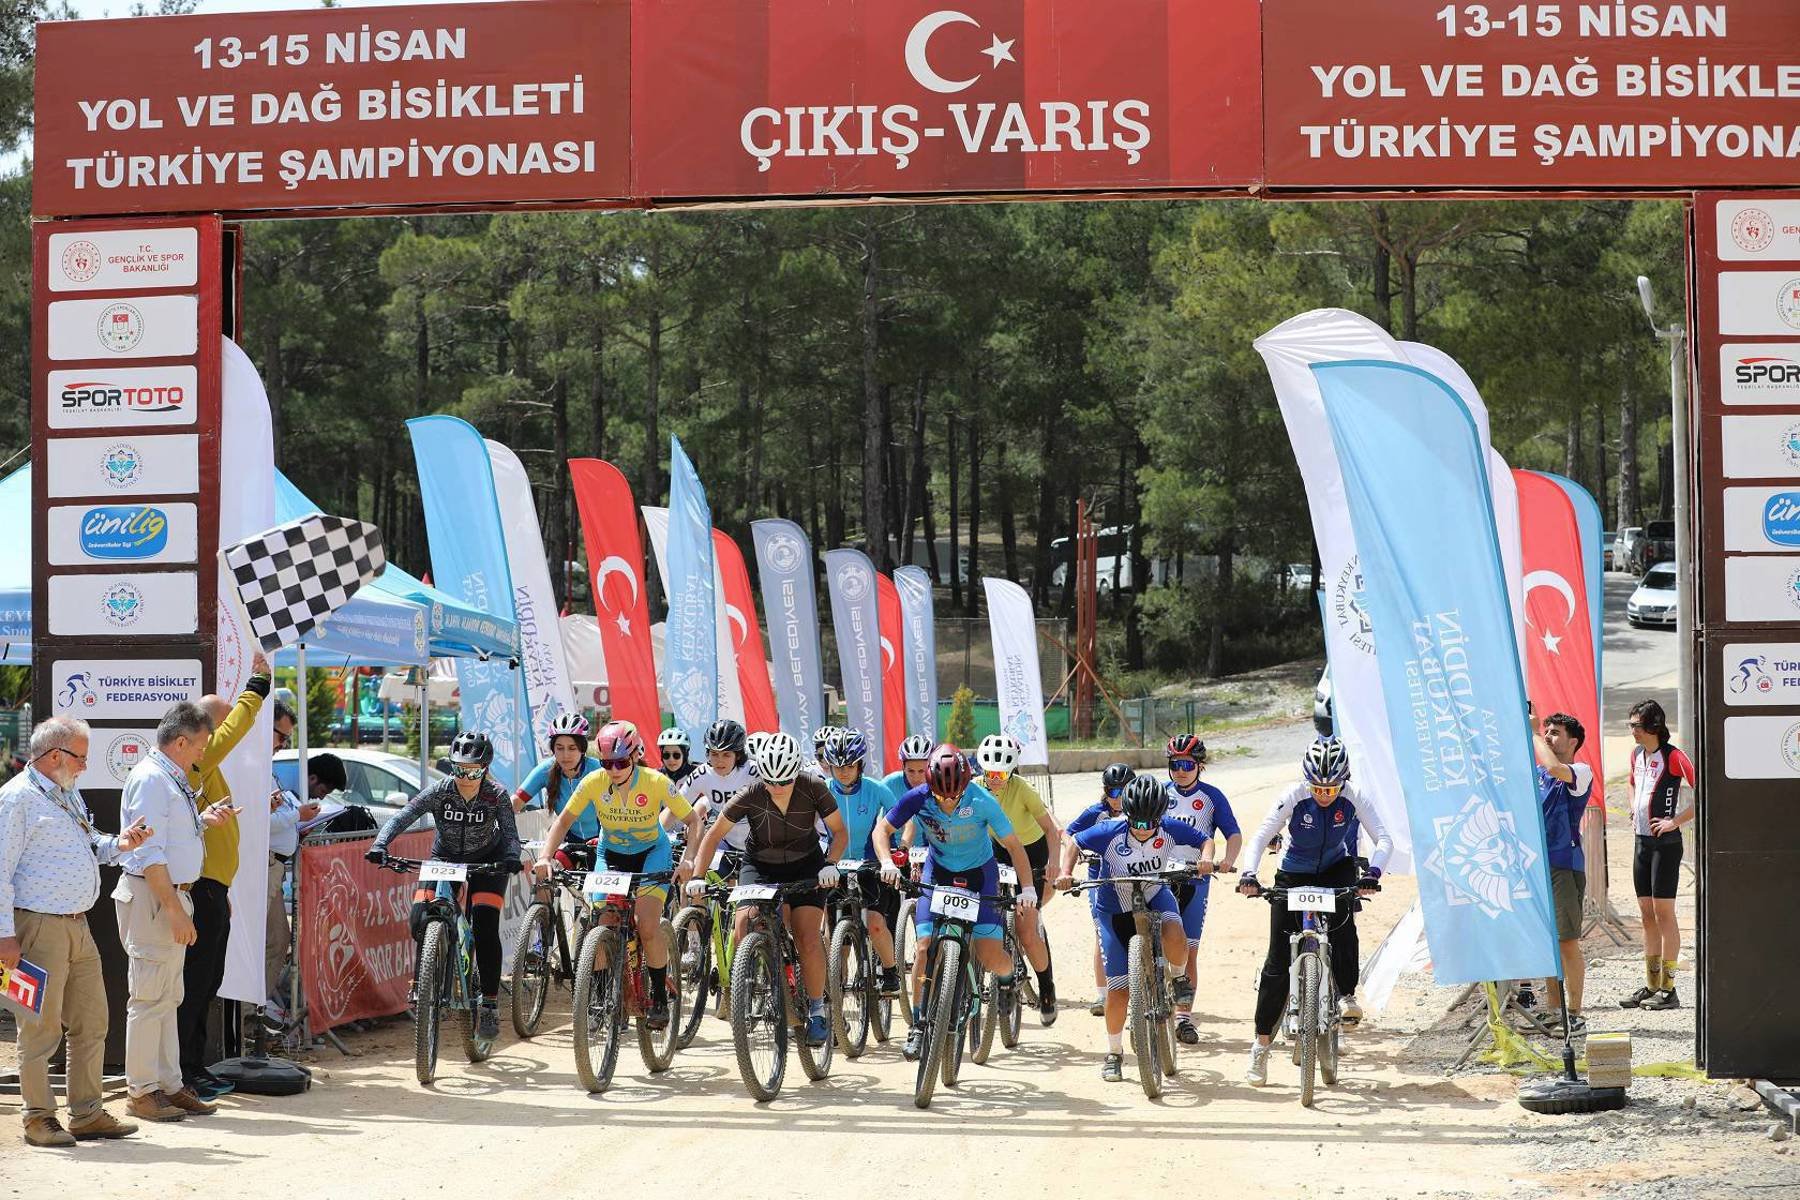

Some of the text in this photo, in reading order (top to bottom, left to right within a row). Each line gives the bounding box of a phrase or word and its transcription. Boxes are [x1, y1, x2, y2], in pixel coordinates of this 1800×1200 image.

[1436, 1, 1727, 38] 13-15 NİSAN
[193, 24, 466, 70] 13-15 NİSAN
[1311, 64, 1406, 98] YOL
[1420, 64, 1484, 97] VE
[1501, 56, 1600, 97] DAĞ
[78, 74, 584, 132] YOL VE DAĞ BİSİKLETİ
[740, 99, 1151, 172] ÇIKIŞ-VARIŞ
[1300, 117, 1517, 159] TÜRKİYE
[67, 138, 597, 190] TÜRKİYE ŞAMPİYONASI
[147, 254, 159, 263] VE
[160, 253, 184, 263] SPOR
[98, 674, 196, 687] TÜRKİYE BİSİKLET
[106, 692, 188, 702] FEDERASYONU
[431, 867, 457, 876] 023
[1127, 856, 1162, 875] KMÜ
[595, 876, 620, 887] 024
[943, 894, 969, 909] 009
[1299, 894, 1323, 904] 001
